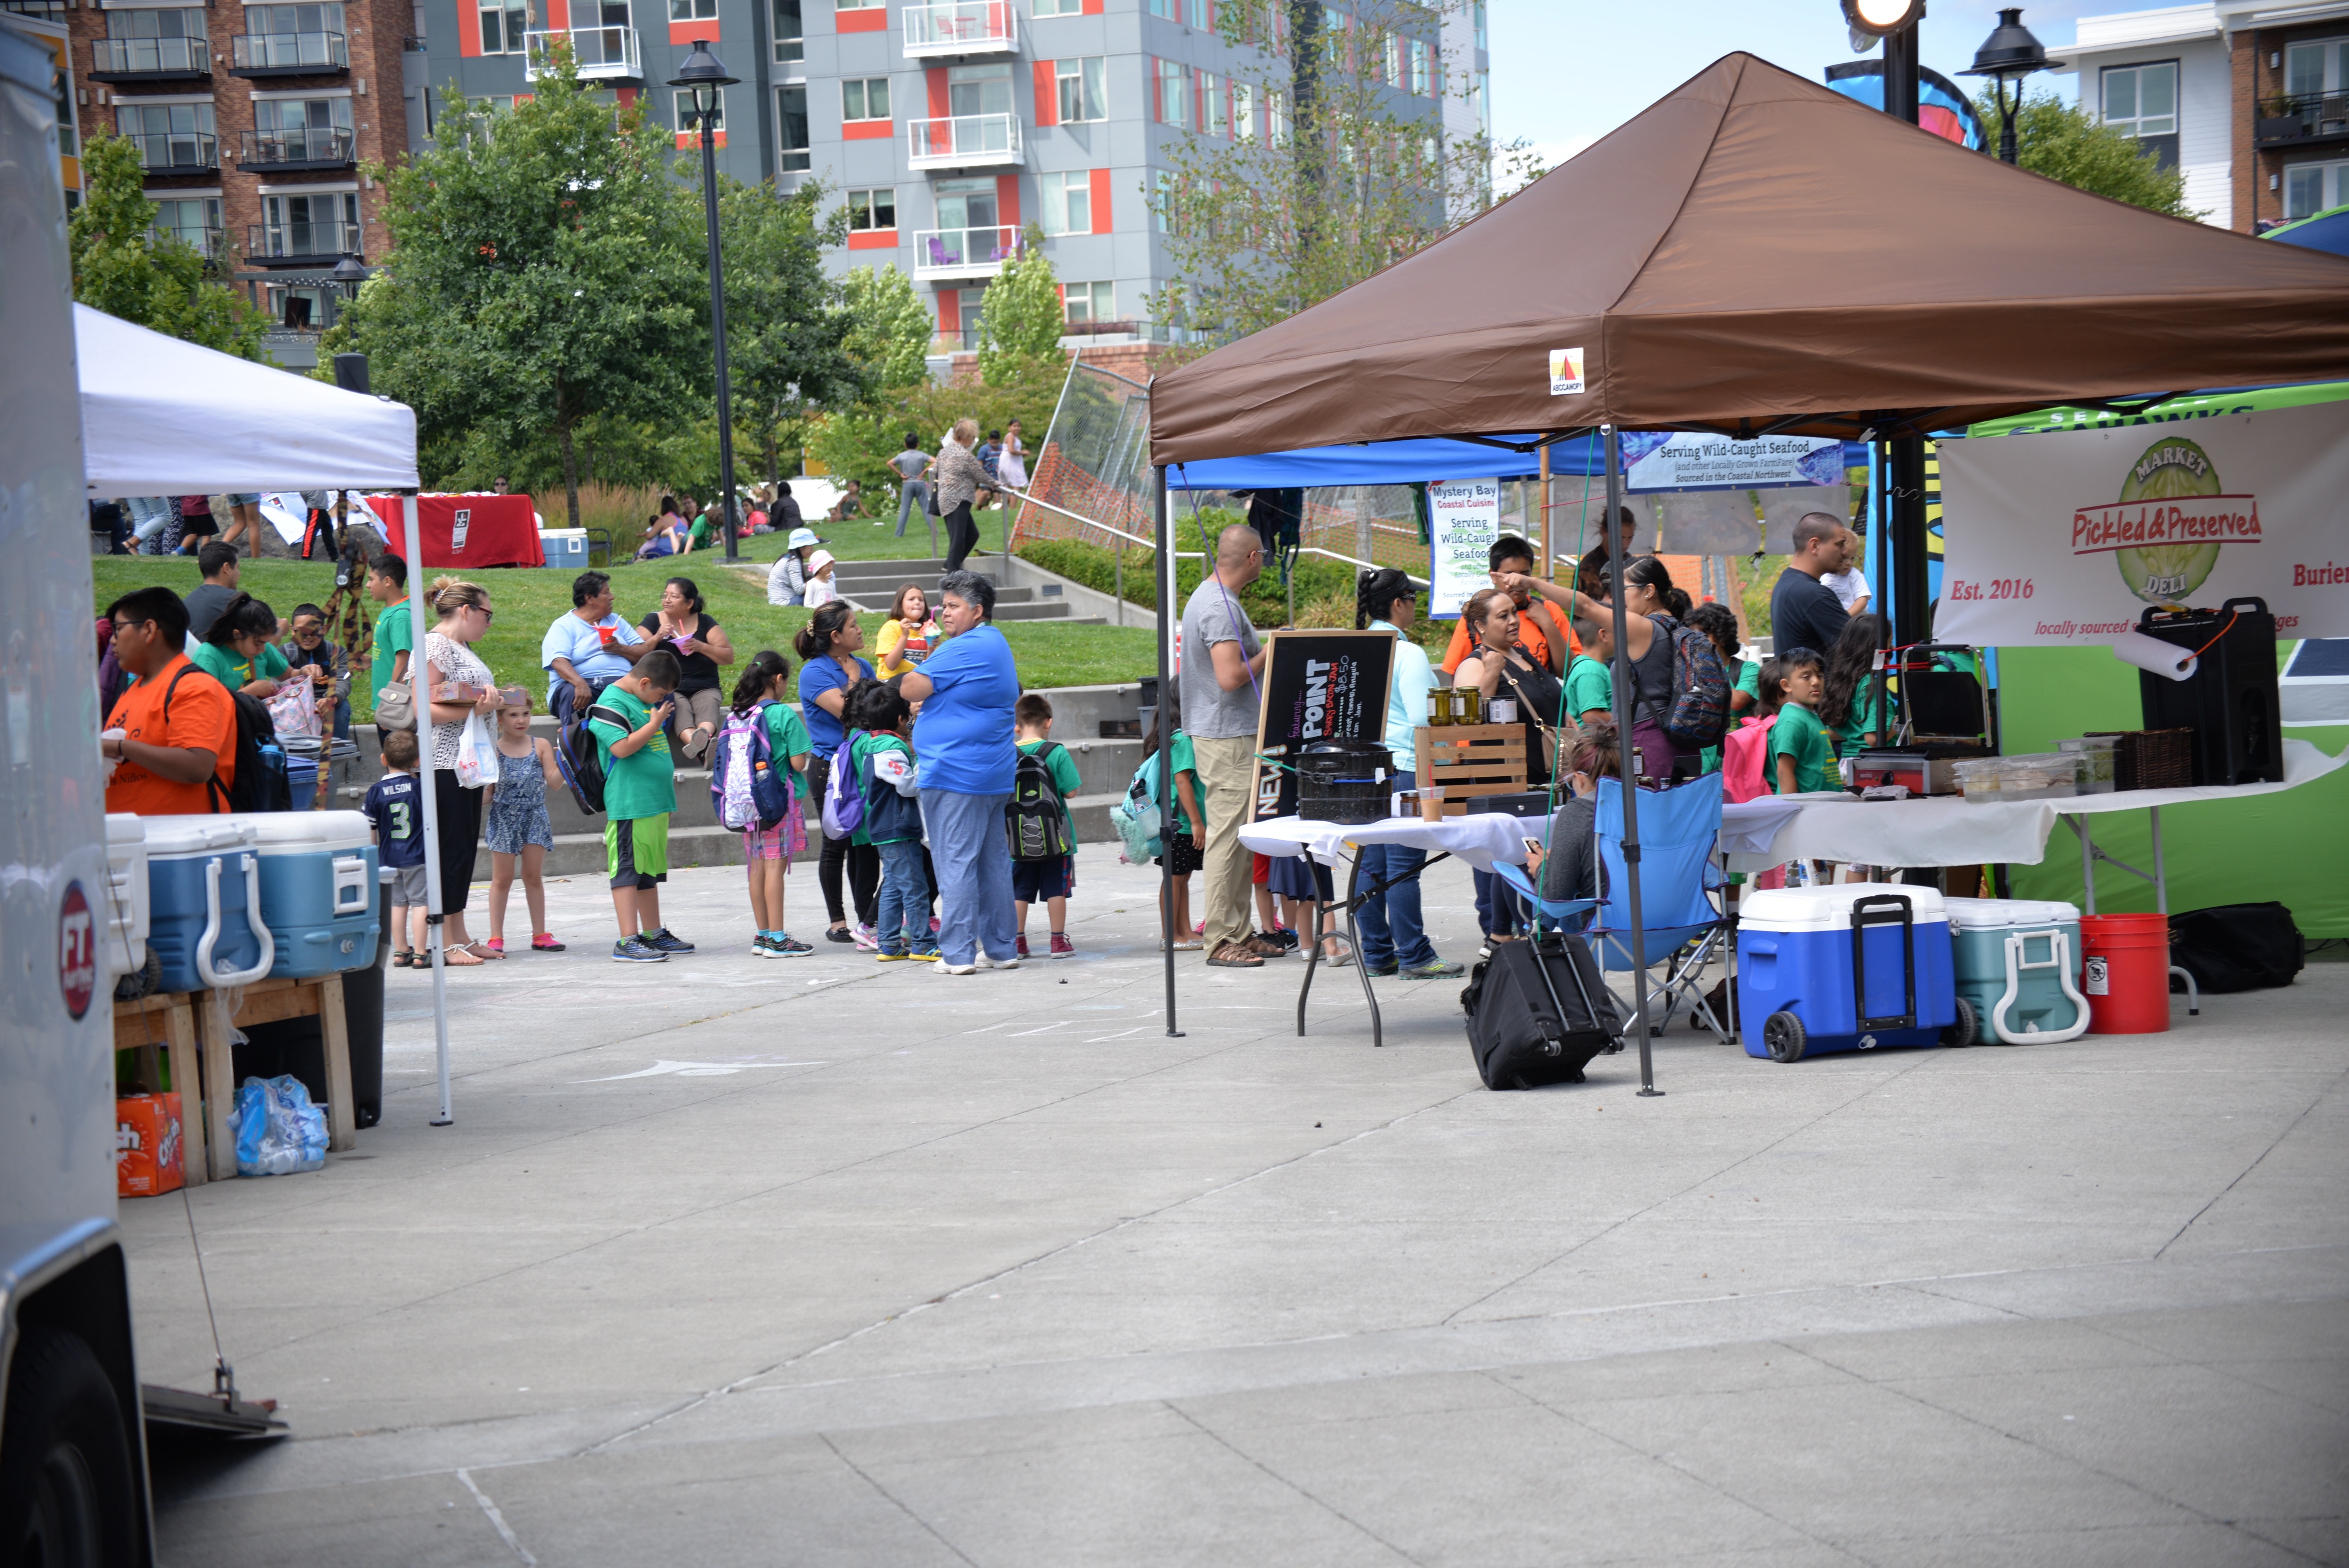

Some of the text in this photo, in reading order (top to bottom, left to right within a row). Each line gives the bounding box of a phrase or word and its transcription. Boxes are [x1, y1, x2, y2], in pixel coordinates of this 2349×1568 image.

[1552, 383, 1583, 391] ABCCANOPY
[1661, 440, 1809, 460] Serving Wild-Caught Seafood
[1675, 462, 1691, 472] (and
[1692, 461, 1710, 470] other
[1711, 460, 1735, 470] Locally
[1736, 460, 1758, 468] Grown
[2135, 447, 2207, 482] MARKET
[1675, 470, 1791, 483] Sourced in the Coastal Northwest
[1433, 485, 1496, 499] Mystery Bay
[1438, 500, 1465, 508] Coastal
[1451, 517, 1488, 530] Serving
[2072, 501, 2262, 547] Pickled & Preserved
[1441, 532, 1495, 545] Wild-Caugh
[1950, 579, 2034, 600] Est. 2016
[2146, 573, 2186, 594] DELI
[2035, 620, 2077, 638] locally
[2079, 619, 2130, 634] sourced
[1335, 655, 1349, 694] $8.50
[1349, 661, 1359, 688] Arugula
[1302, 659, 1330, 739] POINT
[1323, 663, 1339, 736] SAVORY BACON JAM
[889, 761, 903, 775] 3
[120, 773, 147, 784] Niños
[1258, 744, 1287, 814] NEW!
[382, 782, 412, 796] WILSON
[389, 802, 411, 839] 3
